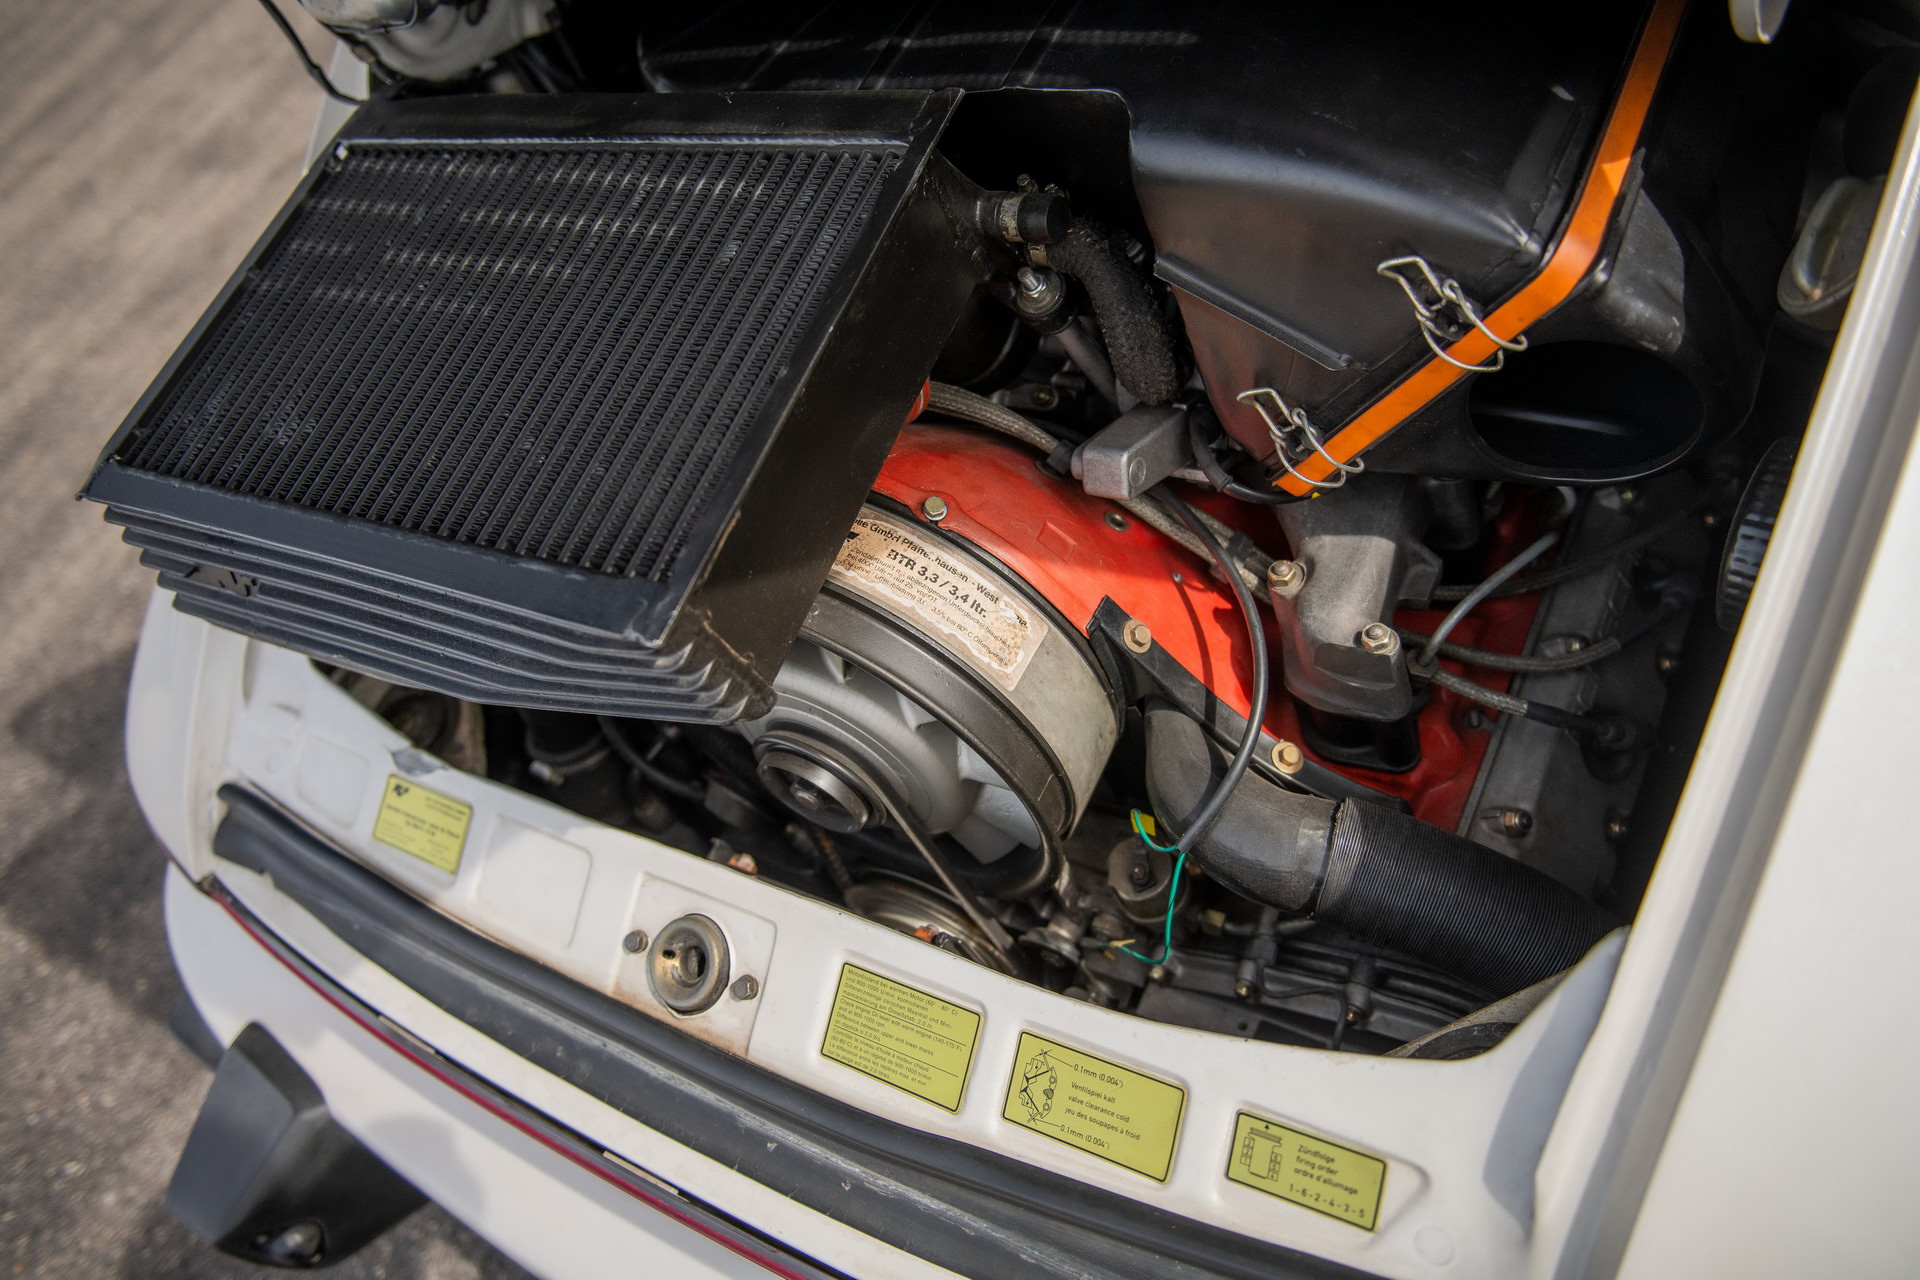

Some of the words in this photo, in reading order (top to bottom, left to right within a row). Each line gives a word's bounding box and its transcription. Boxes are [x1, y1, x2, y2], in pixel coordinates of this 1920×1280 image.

[886, 548, 917, 571] BTR
[917, 565, 940, 583] 3,3
[948, 585, 970, 604] 3,4
[970, 599, 986, 618] ltr.
[976, 582, 1000, 605] West
[910, 993, 924, 1002] Motor
[1071, 1082, 1102, 1099] Ventilspiel
[1103, 1094, 1116, 1103] kalt
[1068, 1095, 1084, 1105] valve
[1085, 1101, 1115, 1117] clearance
[1116, 1113, 1129, 1122] cold
[1065, 1108, 1075, 1116] jeu
[1076, 1111, 1088, 1120] des
[1088, 1117, 1118, 1133] soupapes
[1125, 1130, 1140, 1140] froid
[1294, 1167, 1313, 1179] ordre
[1296, 1156, 1315, 1169] firing
[1318, 1163, 1338, 1175] order
